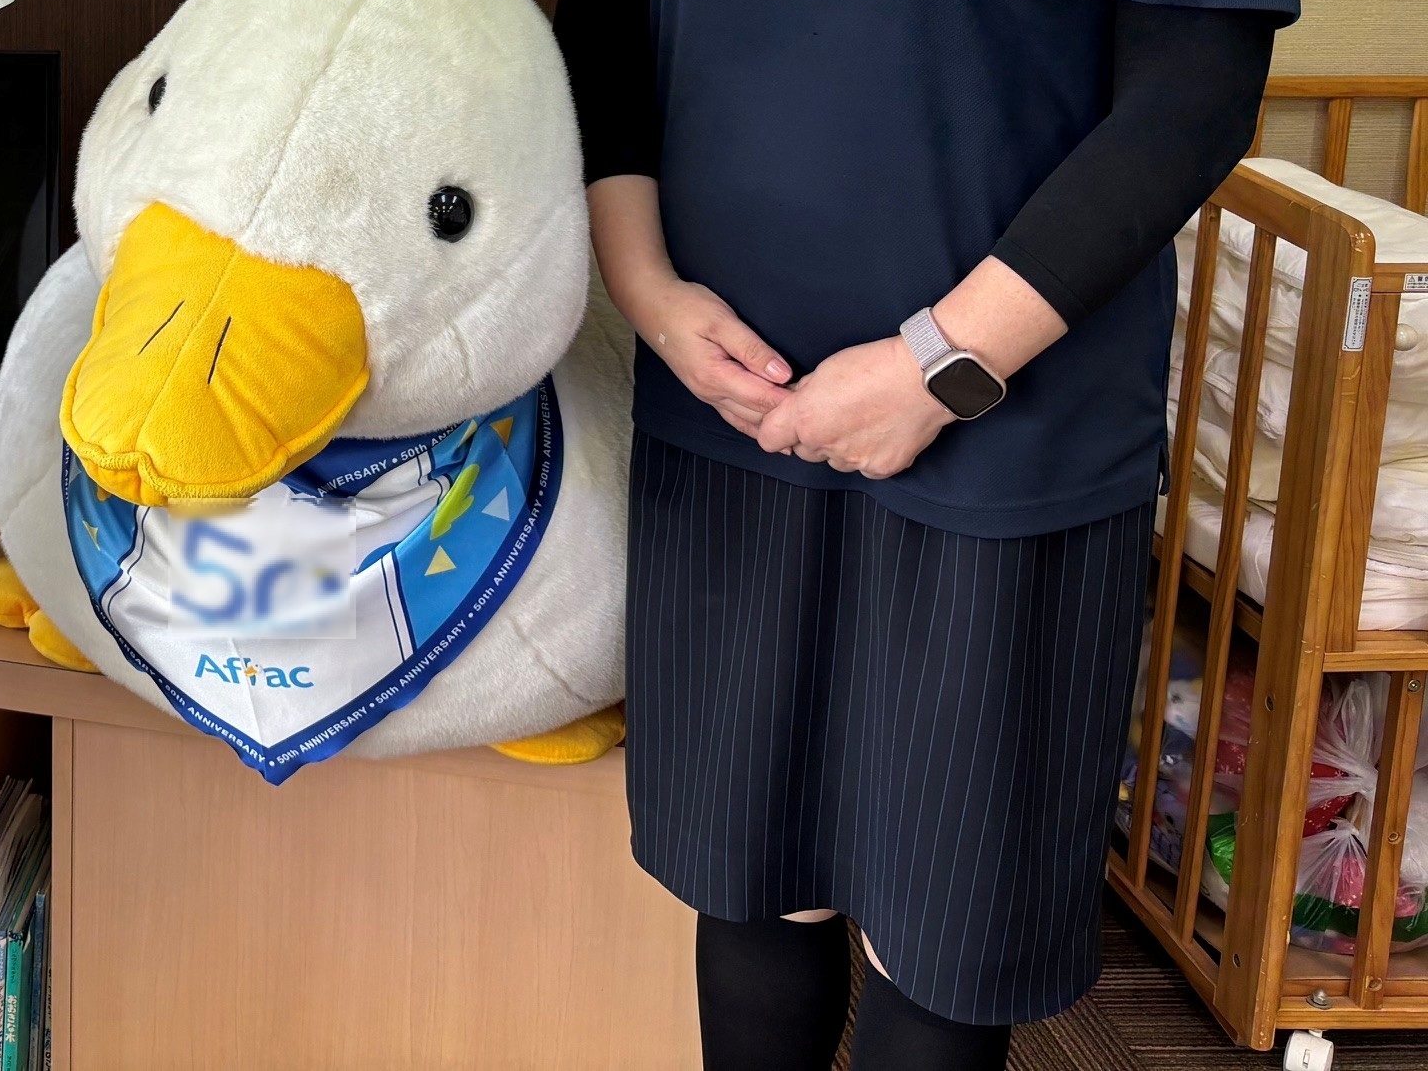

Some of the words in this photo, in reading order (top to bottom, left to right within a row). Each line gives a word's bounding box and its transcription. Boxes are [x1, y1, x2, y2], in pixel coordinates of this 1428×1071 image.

[400, 444, 427, 461] 50th
[276, 748, 300, 764] 50th
[299, 706, 368, 753] ANNIVERSARY
[375, 685, 399, 704] 50th
[399, 619, 467, 687] ANNIVERSARY
[473, 587, 495, 612] 50th
[493, 499, 543, 587] ANNIVERSARY
[539, 461, 551, 488] 50th
[194, 653, 314, 689] Aflac
[187, 706, 266, 763] ANNIVERSARY
